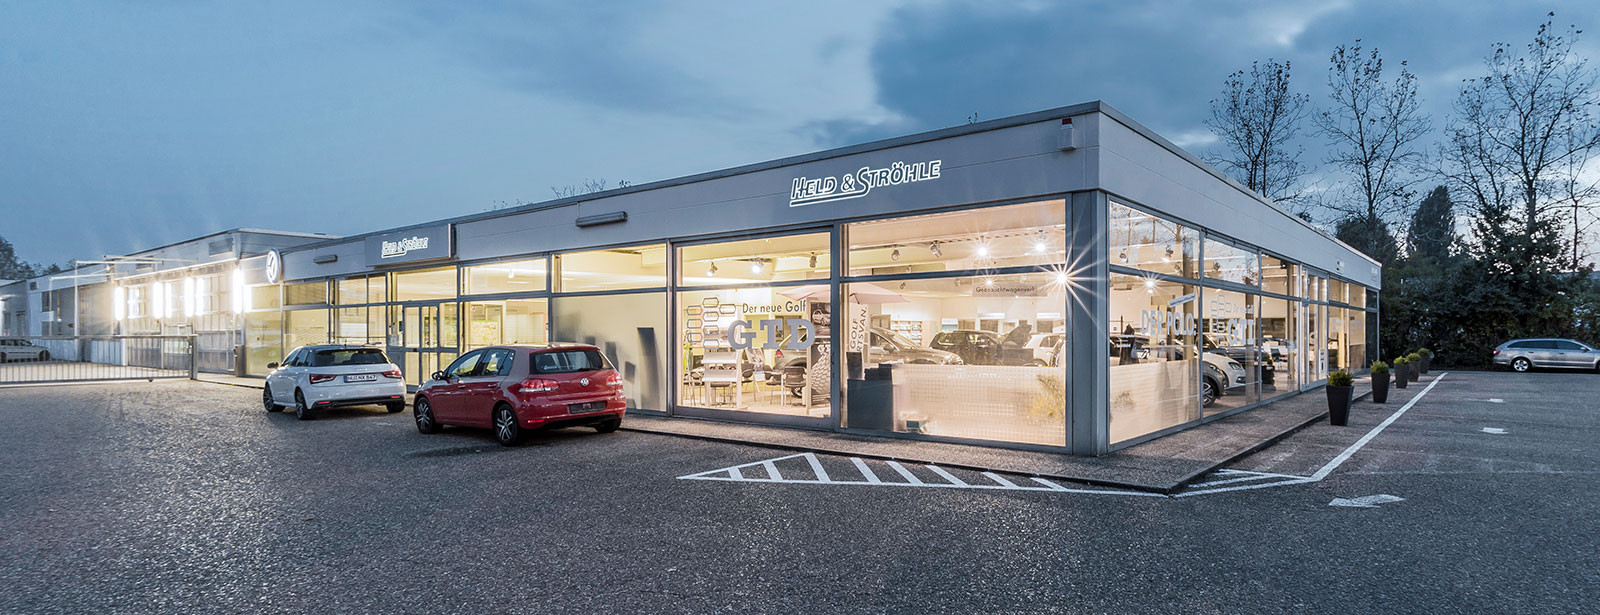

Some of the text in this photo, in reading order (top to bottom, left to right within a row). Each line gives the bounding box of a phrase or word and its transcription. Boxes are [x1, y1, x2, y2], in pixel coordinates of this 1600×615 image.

[791, 160, 942, 200] HELD & STRÖHLE
[742, 299, 807, 314] Der neue Golf
[727, 318, 816, 350] GTD
[849, 318, 859, 349] GOLF
[856, 307, 868, 352] RTSVAN.
[1141, 309, 1197, 337] DER POLO.
[1228, 318, 1255, 346] GTI
